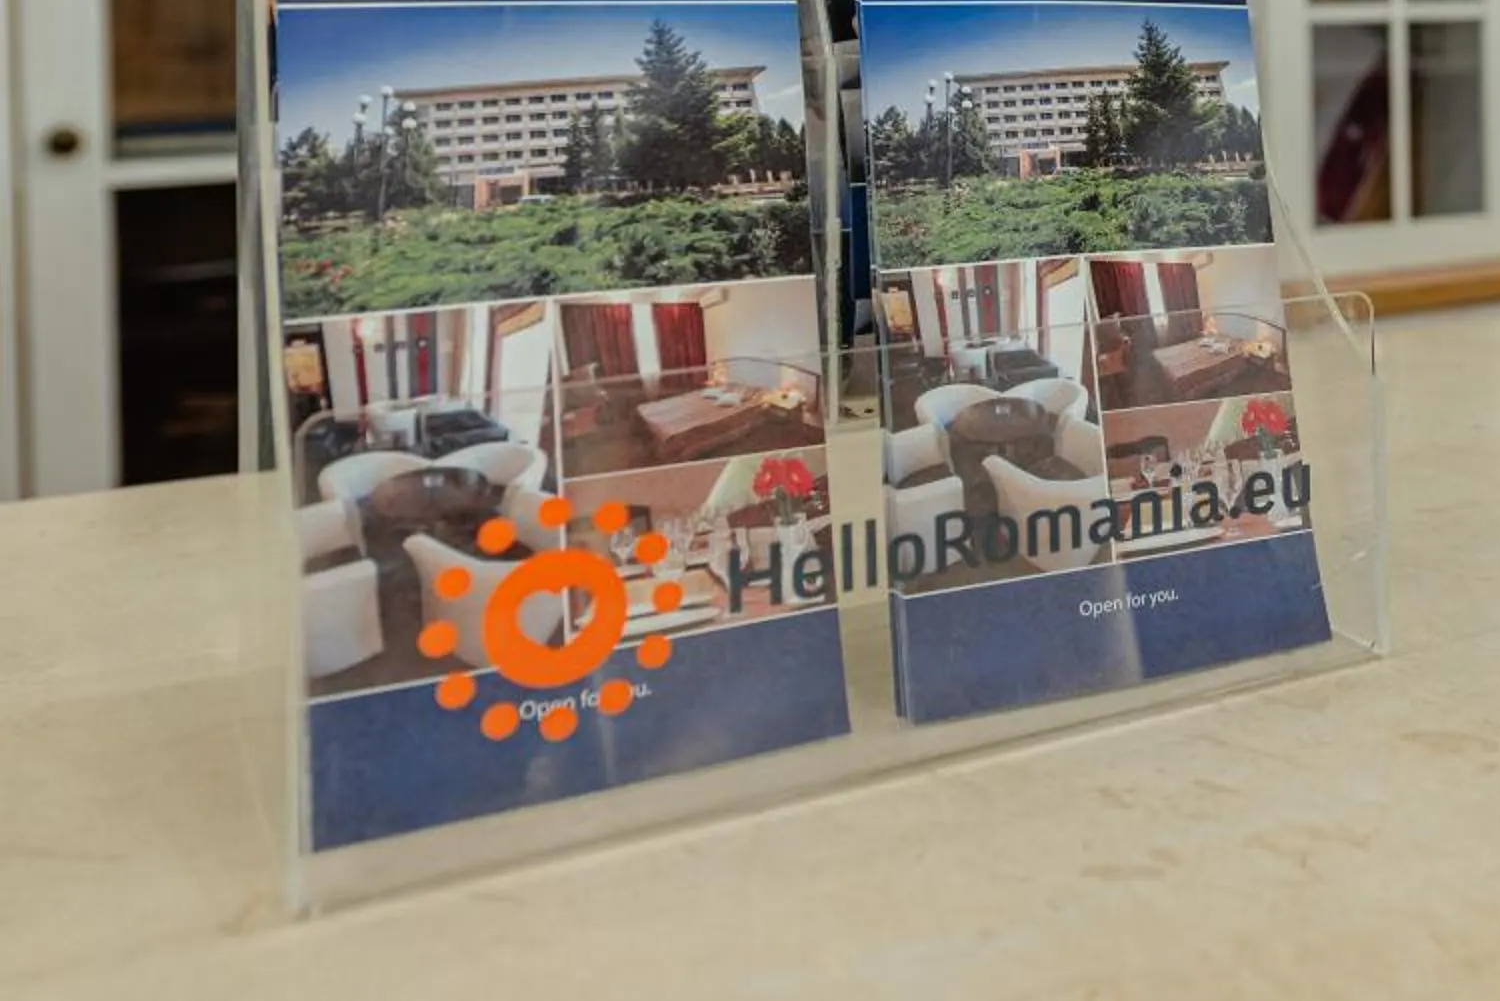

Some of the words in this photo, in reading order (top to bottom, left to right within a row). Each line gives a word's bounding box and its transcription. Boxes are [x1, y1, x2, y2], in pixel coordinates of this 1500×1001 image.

[1079, 598, 1123, 619] Open
[1125, 591, 1146, 609] for
[1149, 589, 1179, 609] you.
[580, 688, 602, 708] fo
